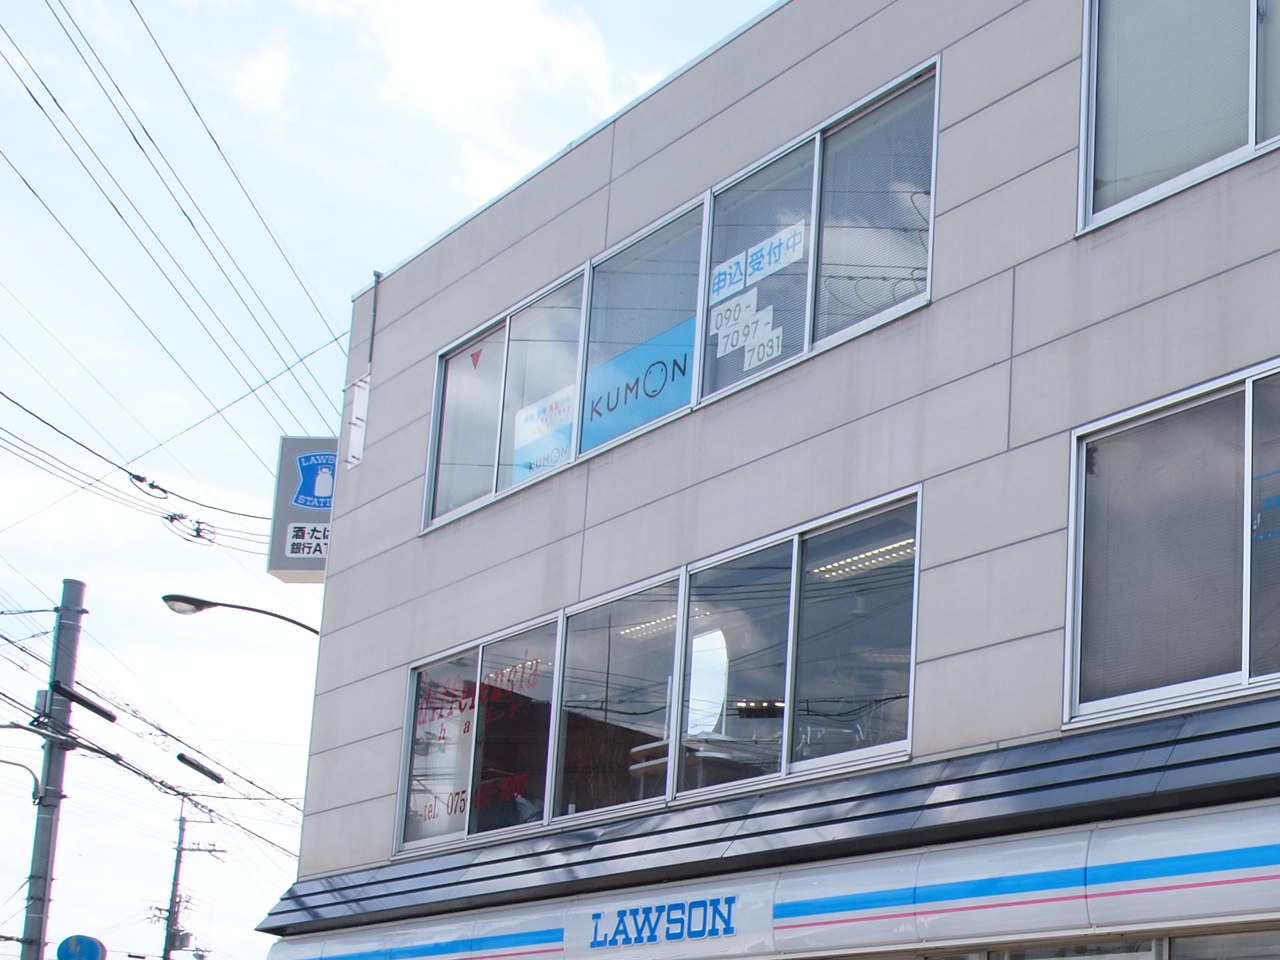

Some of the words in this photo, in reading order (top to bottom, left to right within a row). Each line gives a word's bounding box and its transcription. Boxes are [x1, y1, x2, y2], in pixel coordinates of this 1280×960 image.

[712, 229, 803, 296] 申込受付中
[748, 335, 781, 367] 7031
[590, 353, 687, 421] KUMON
[590, 896, 737, 949] LAWSON
